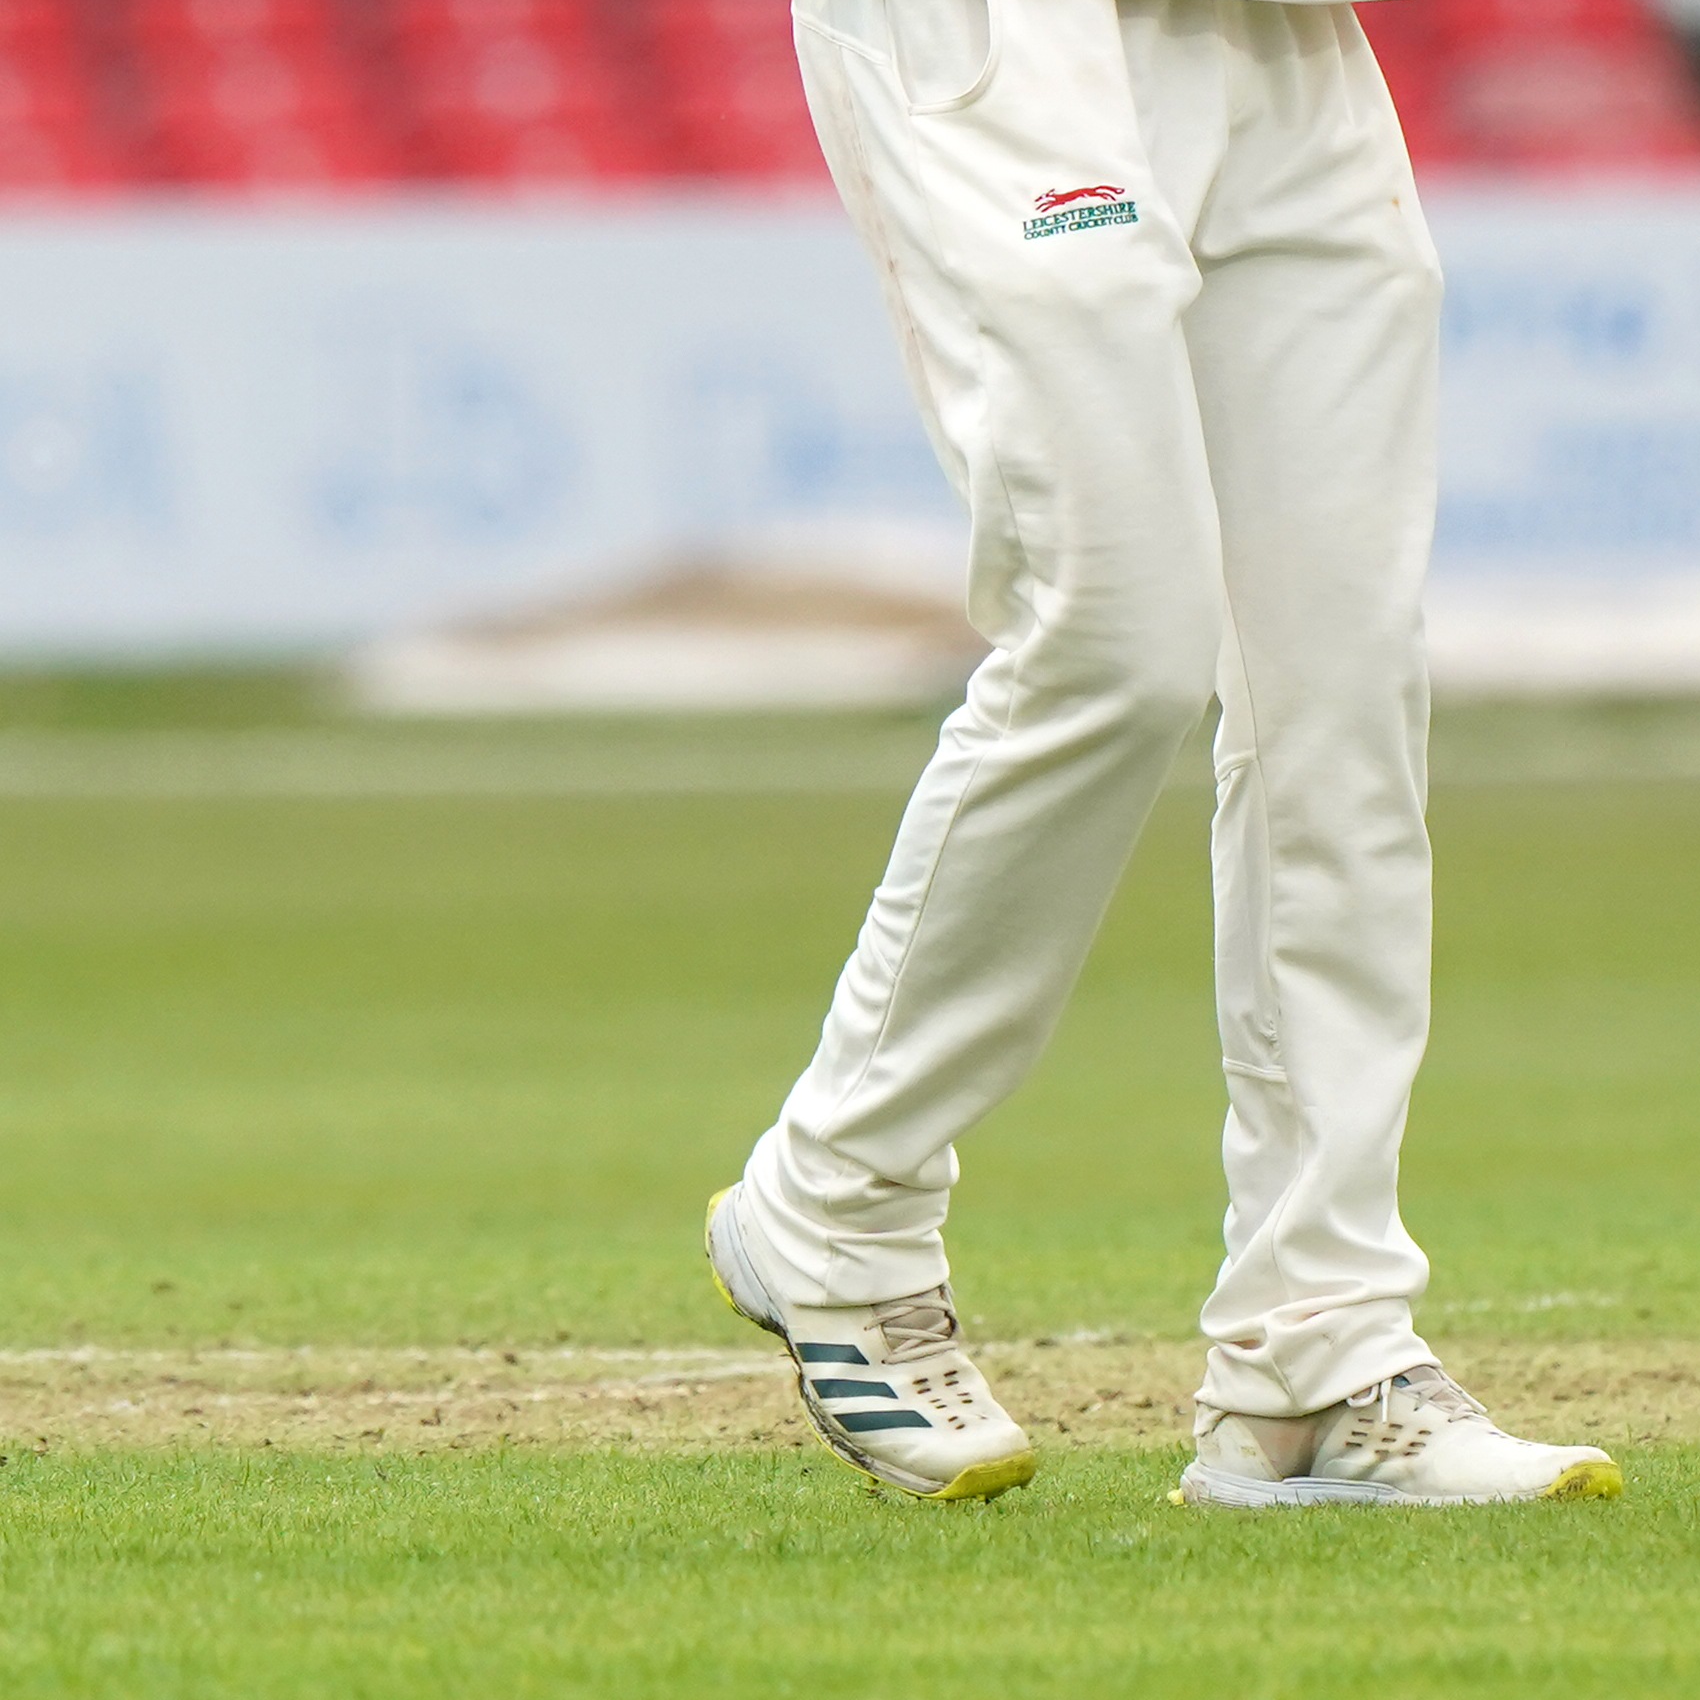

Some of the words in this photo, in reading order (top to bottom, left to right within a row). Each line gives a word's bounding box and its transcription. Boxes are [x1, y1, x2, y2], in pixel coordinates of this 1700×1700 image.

[1023, 201, 1136, 232] LEICESTERSHIRE
[1024, 225, 1066, 240] COUNTY
[1068, 216, 1113, 231] CRICKET
[1113, 213, 1139, 225] CLUB
